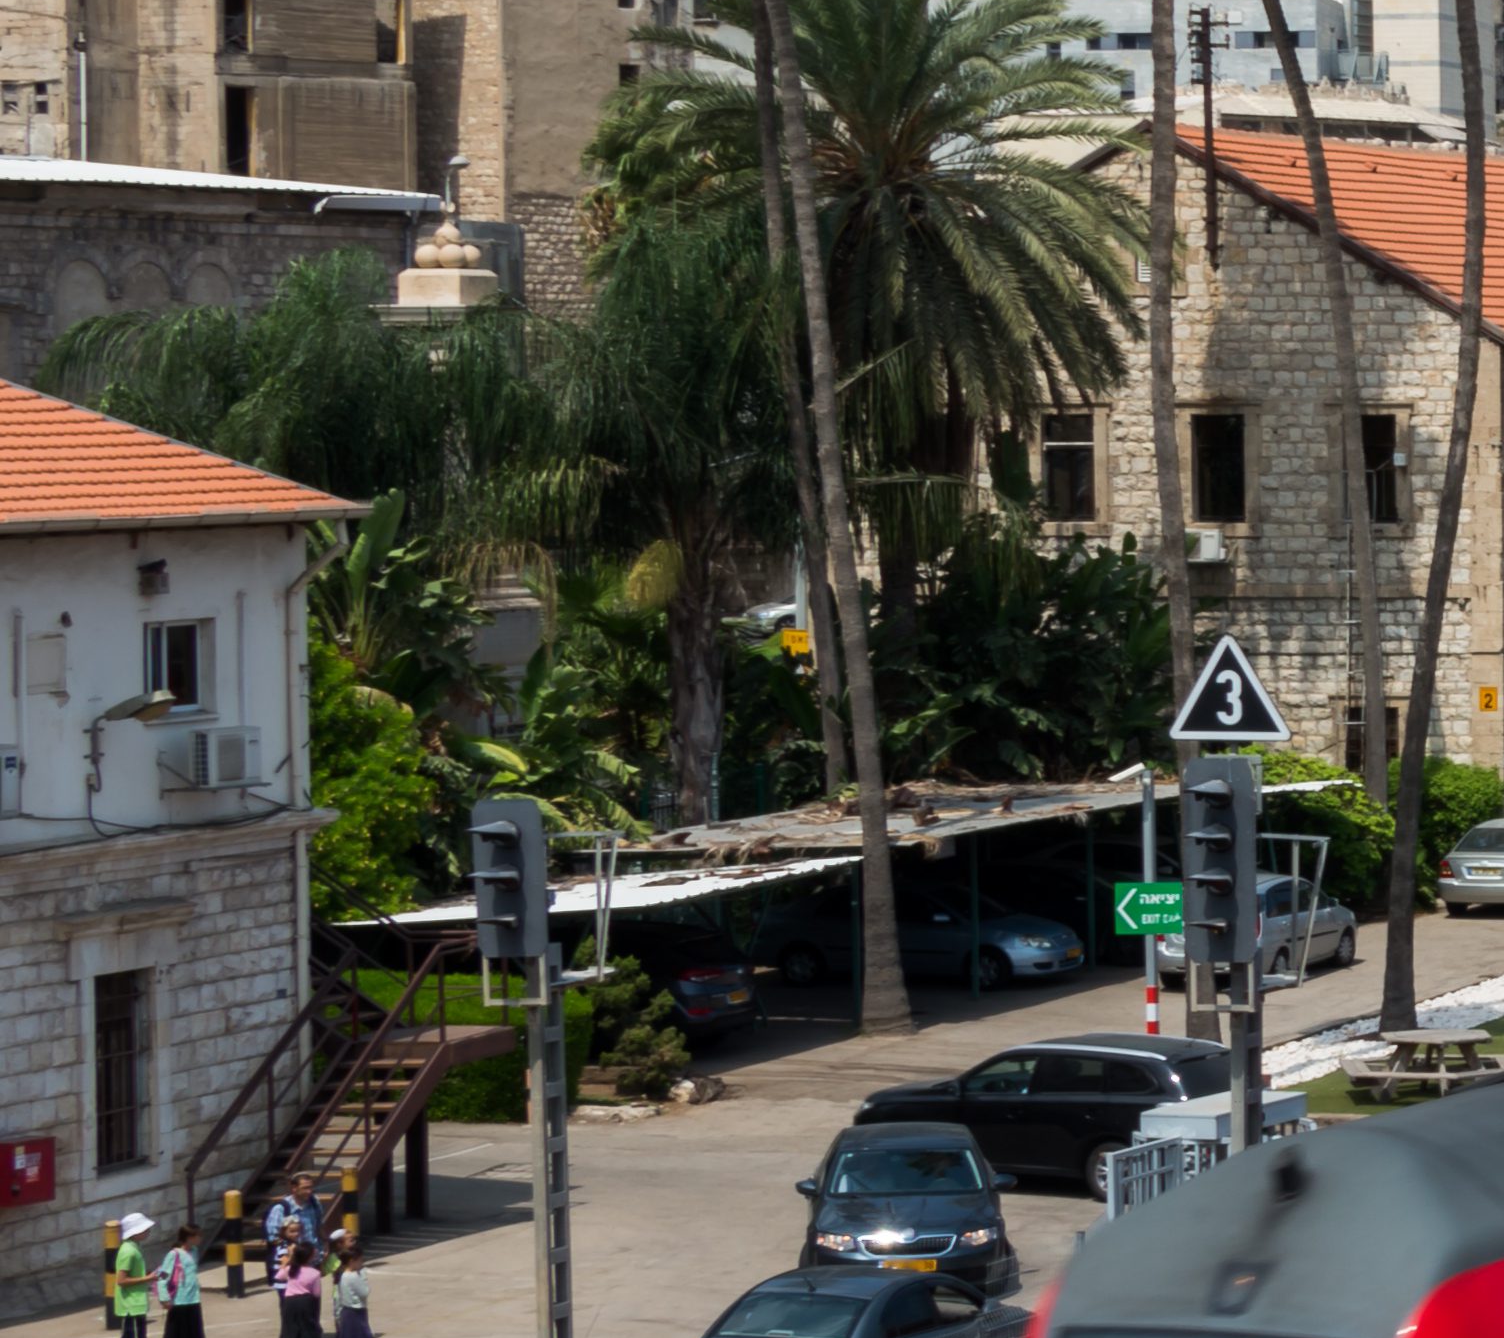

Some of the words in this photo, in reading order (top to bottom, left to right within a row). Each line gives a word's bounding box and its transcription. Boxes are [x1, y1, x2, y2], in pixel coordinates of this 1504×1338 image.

[1215, 669, 1243, 726] 3
[1484, 692, 1494, 709] 2
[1138, 893, 1181, 905] יציאה
